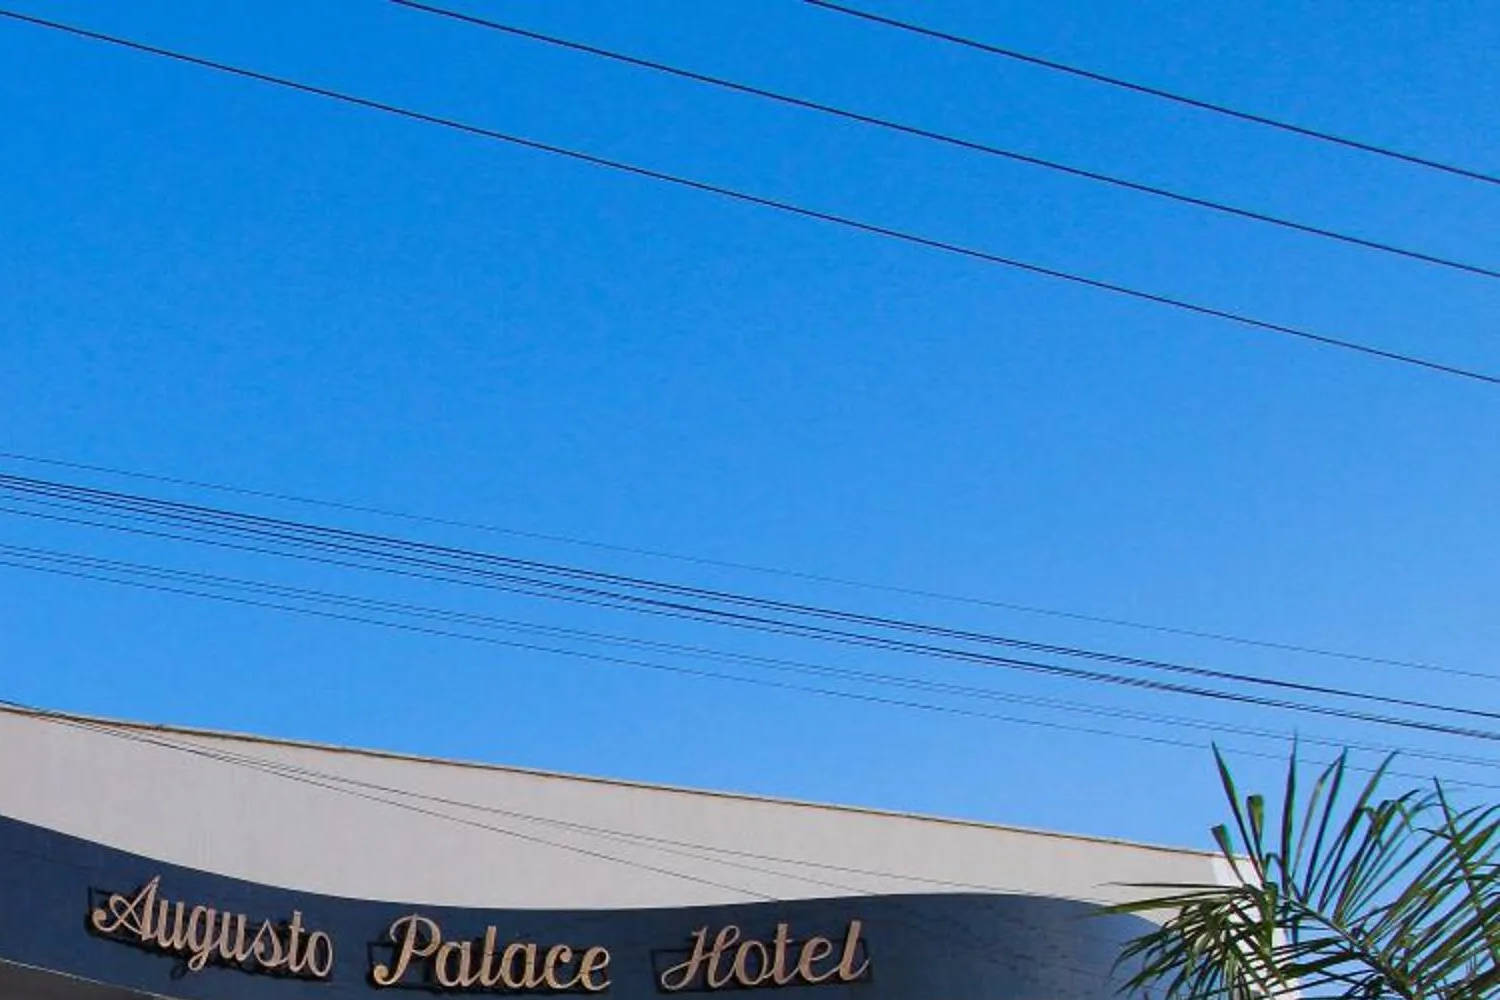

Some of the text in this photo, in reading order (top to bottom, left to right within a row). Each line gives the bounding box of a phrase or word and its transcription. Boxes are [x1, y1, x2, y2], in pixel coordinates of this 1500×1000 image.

[91, 873, 872, 991] Augusto Palace Hotel
